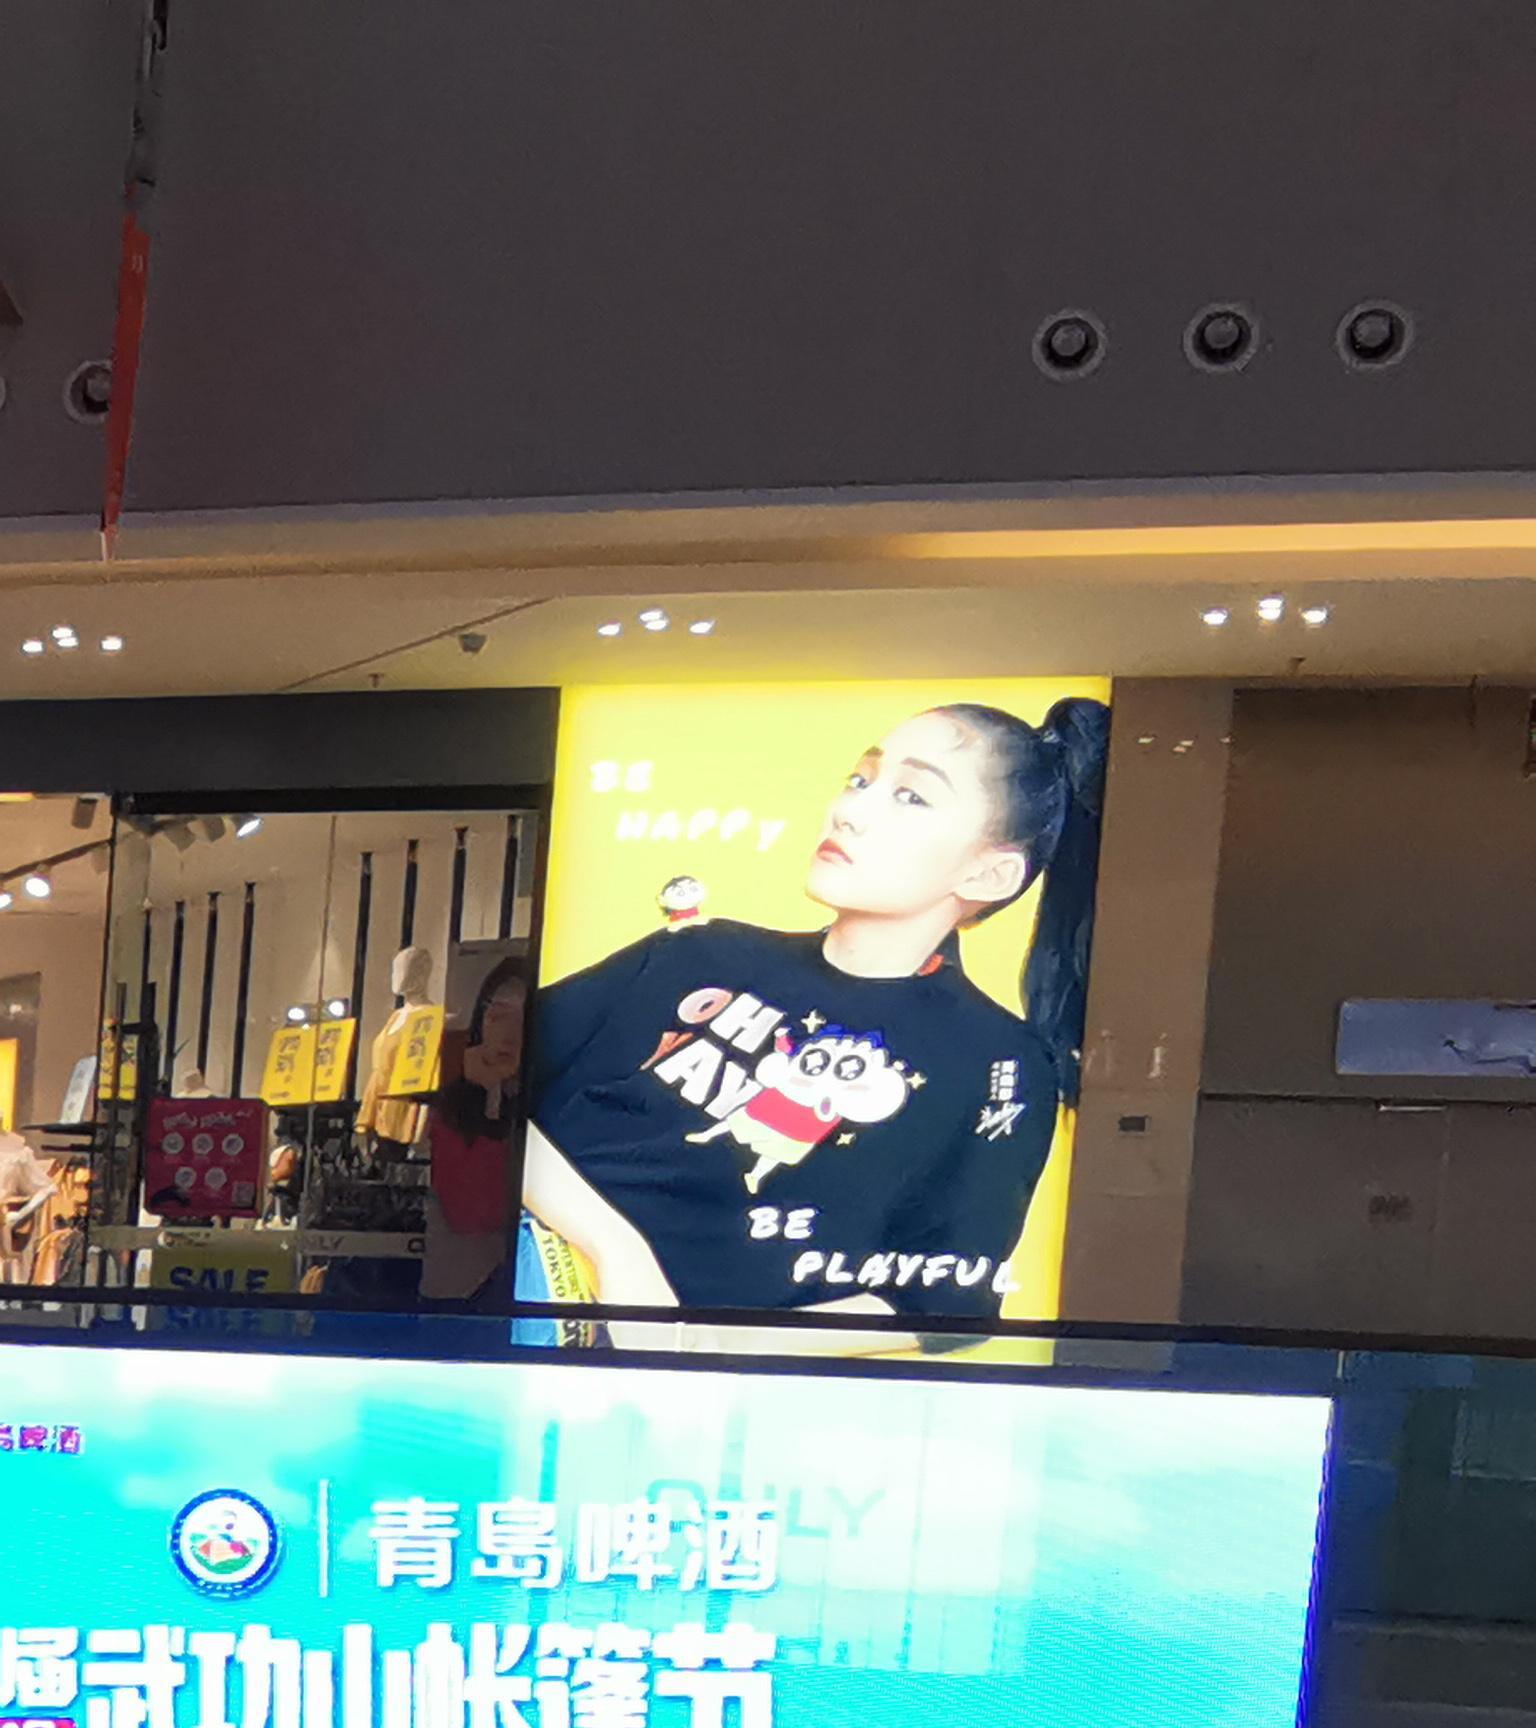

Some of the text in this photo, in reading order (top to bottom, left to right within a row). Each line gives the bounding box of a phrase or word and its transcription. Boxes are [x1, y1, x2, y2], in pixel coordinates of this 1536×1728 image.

[589, 758, 654, 793] BE
[614, 807, 787, 853] HAPPY
[678, 987, 787, 1054] OH
[639, 1031, 765, 1120] YAY
[748, 1206, 817, 1240] BE
[792, 1250, 1021, 1294] PLAYFUL
[369, 1500, 777, 1592] 青岛啤酒
